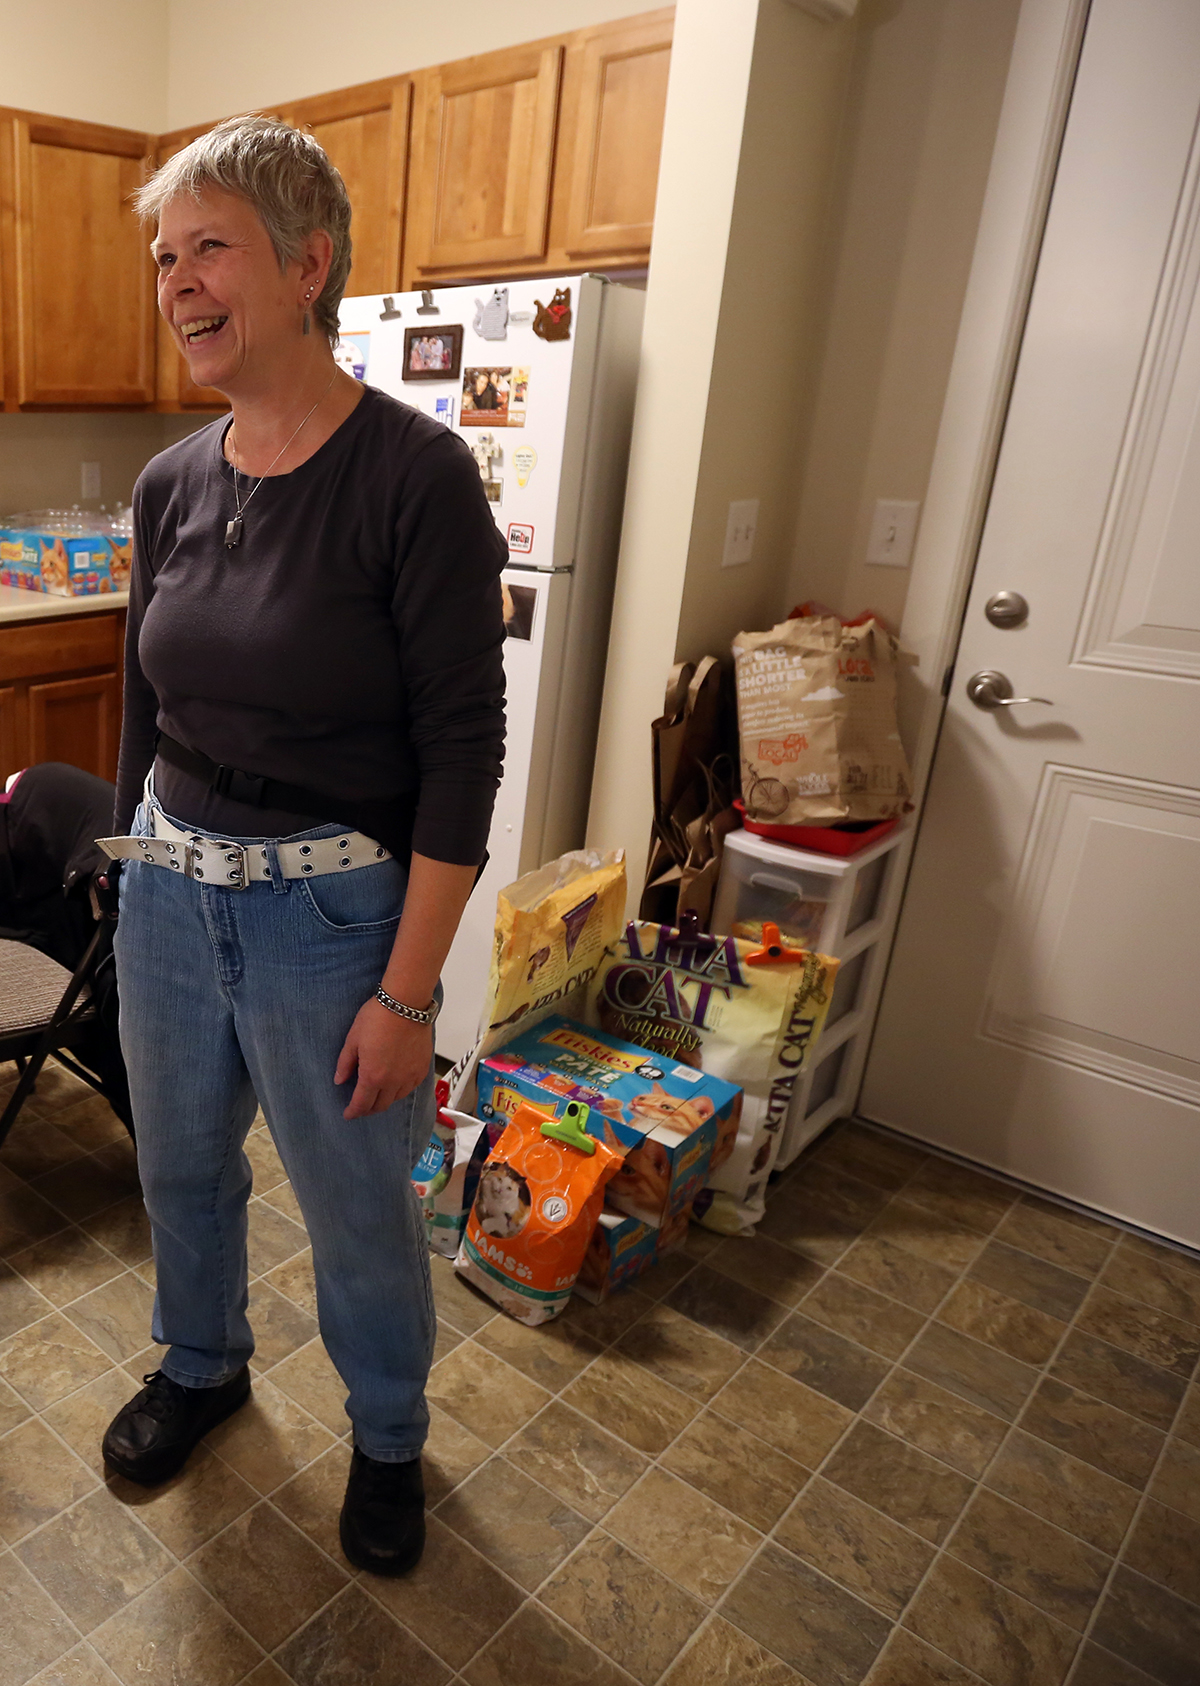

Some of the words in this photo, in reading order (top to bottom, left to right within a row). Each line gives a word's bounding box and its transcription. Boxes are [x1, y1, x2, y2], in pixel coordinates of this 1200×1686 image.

[754, 646, 787, 661] BAG
[752, 656, 803, 674] LITTLE
[739, 668, 807, 690] SHORTER
[740, 688, 761, 699] THAN
[761, 749, 795, 760] LOCAL
[603, 962, 733, 1033] CAT
[615, 1013, 704, 1052] Naturally
[778, 1009, 816, 1068] CAT
[552, 1032, 632, 1070] Friskies
[496, 1091, 518, 1114] Fris
[418, 1147, 443, 1169] NE
[474, 1229, 517, 1272] IAMS
